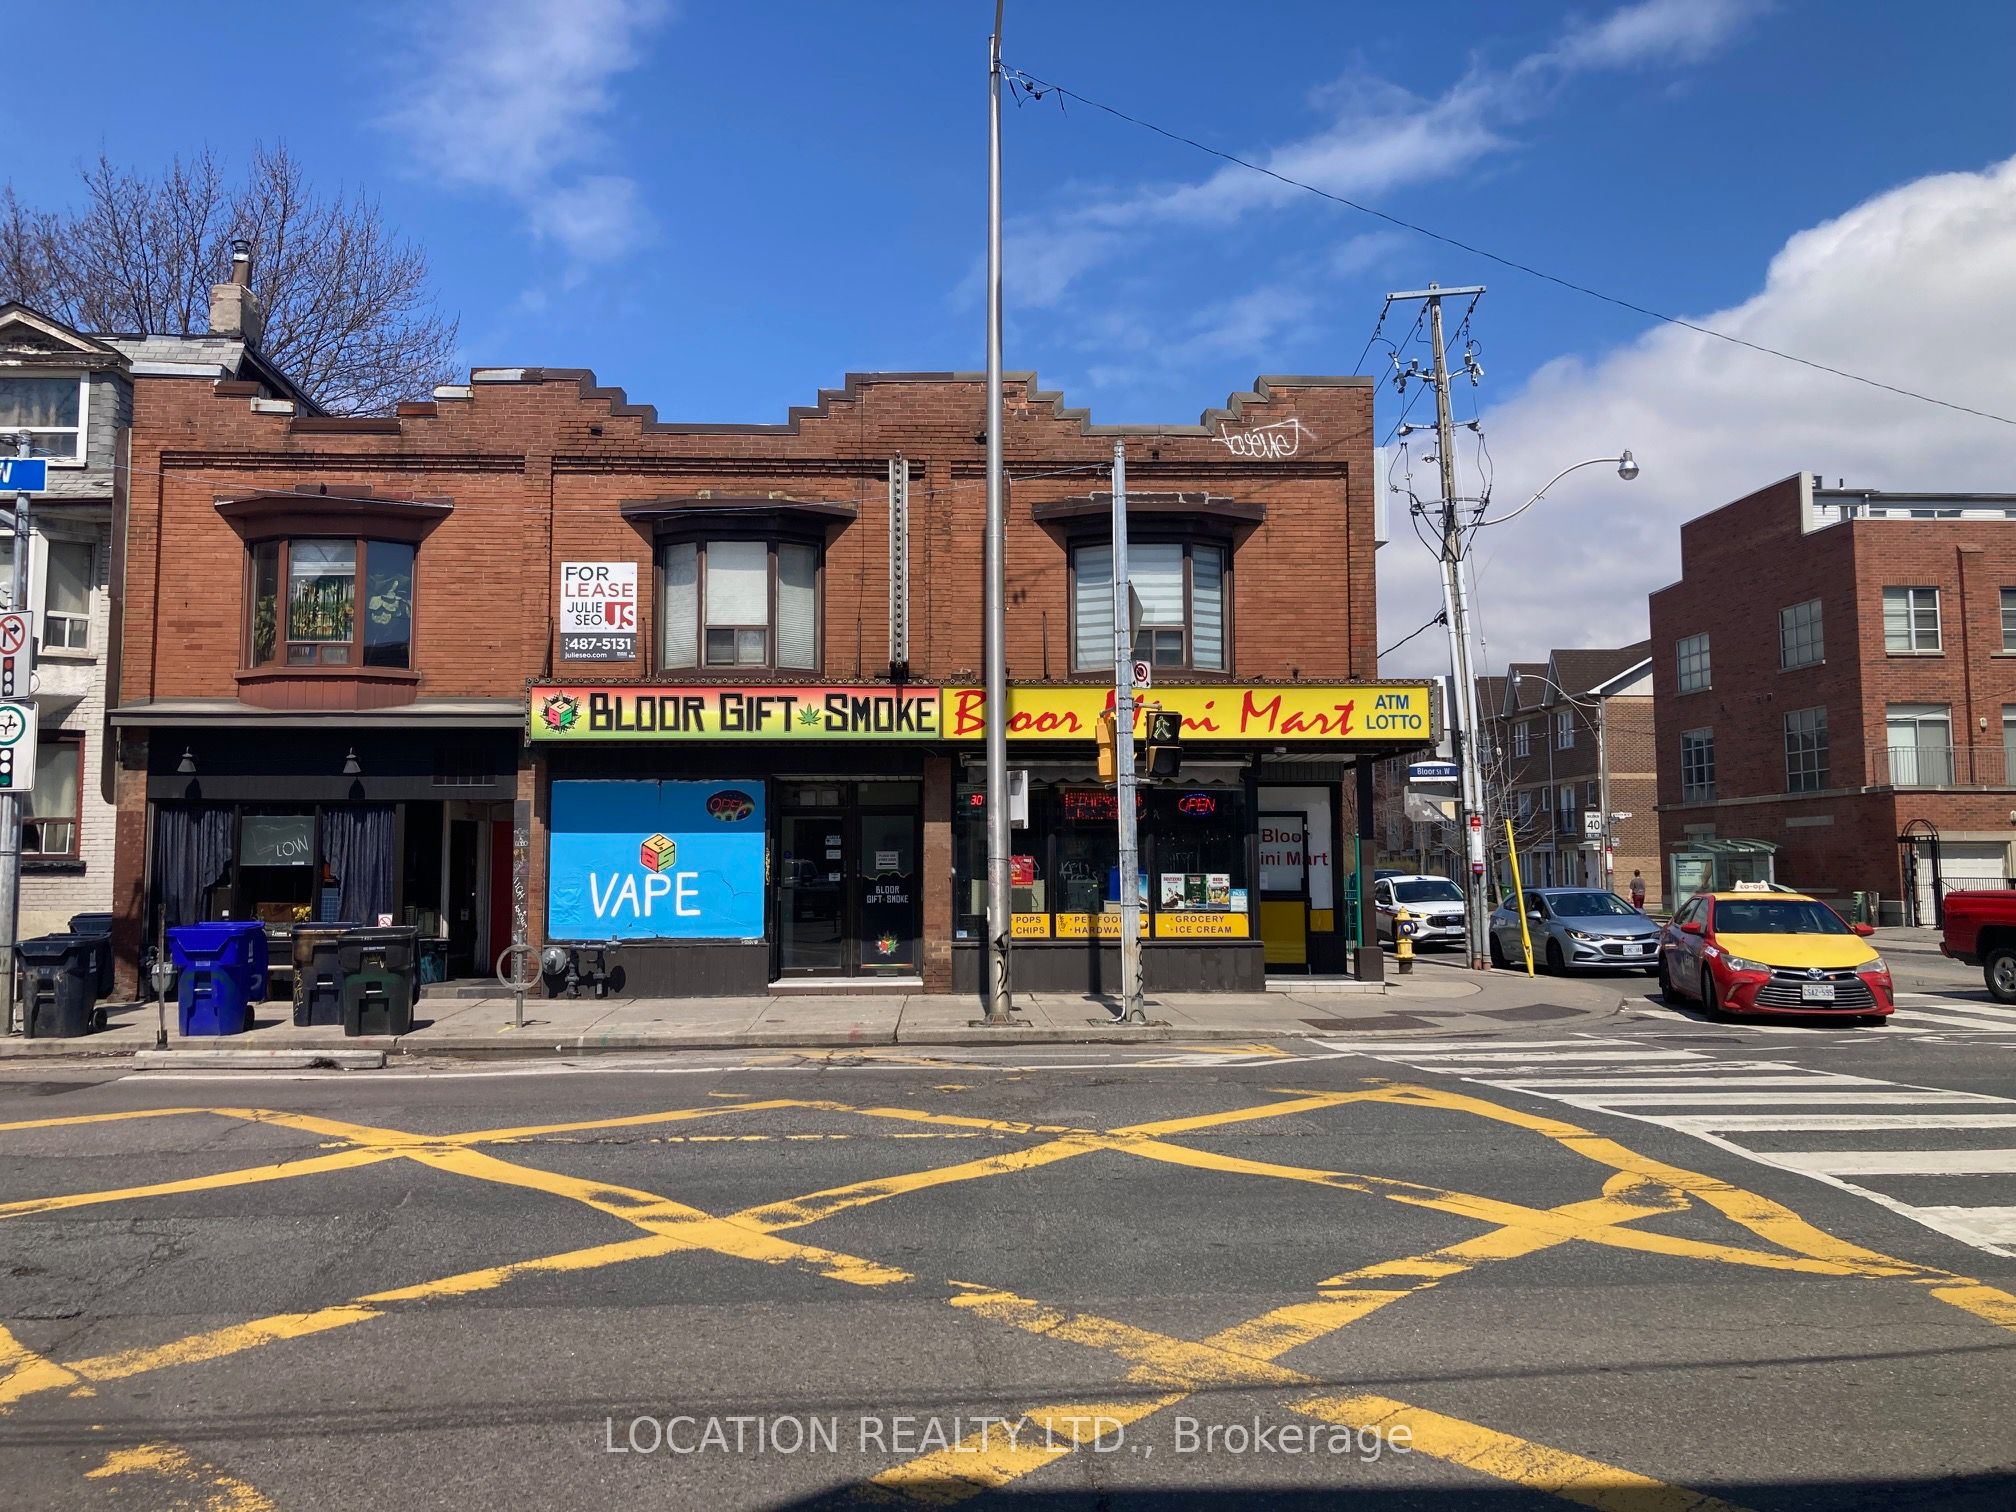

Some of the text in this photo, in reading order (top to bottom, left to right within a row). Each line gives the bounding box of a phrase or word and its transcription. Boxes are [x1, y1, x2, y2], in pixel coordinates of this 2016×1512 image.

[565, 566, 609, 581] FOR
[565, 583, 633, 597] LEASE
[567, 602, 602, 613] JULIE
[575, 615, 602, 625] SEO
[569, 638, 631, 650] 487-5131
[565, 652, 607, 660] julieseo.com
[1375, 695, 1409, 709] ATM
[589, 692, 936, 732] BLOOR GIFT SMOKE
[953, 689, 1082, 735] Boor
[1240, 690, 1355, 735] Mart
[1366, 715, 1422, 730] LOTTO
[1416, 767, 1435, 775] Bloor
[1444, 767, 1450, 775] W
[971, 795, 983, 805] 30
[1179, 798, 1215, 812] OPEN
[1587, 820, 1600, 830] 40
[876, 885, 900, 894] BLOOR
[590, 872, 701, 918] VAPE
[866, 894, 909, 903] GIFT SMOKE
[1016, 916, 1042, 924] POPS
[1074, 916, 1093, 924] PET
[1097, 916, 1121, 924] FOO
[1175, 915, 1225, 924] GROCERY
[1016, 926, 1045, 935] CHIPS
[1074, 926, 1120, 934] HARDWA
[1175, 926, 1232, 934] ICE CREAM
